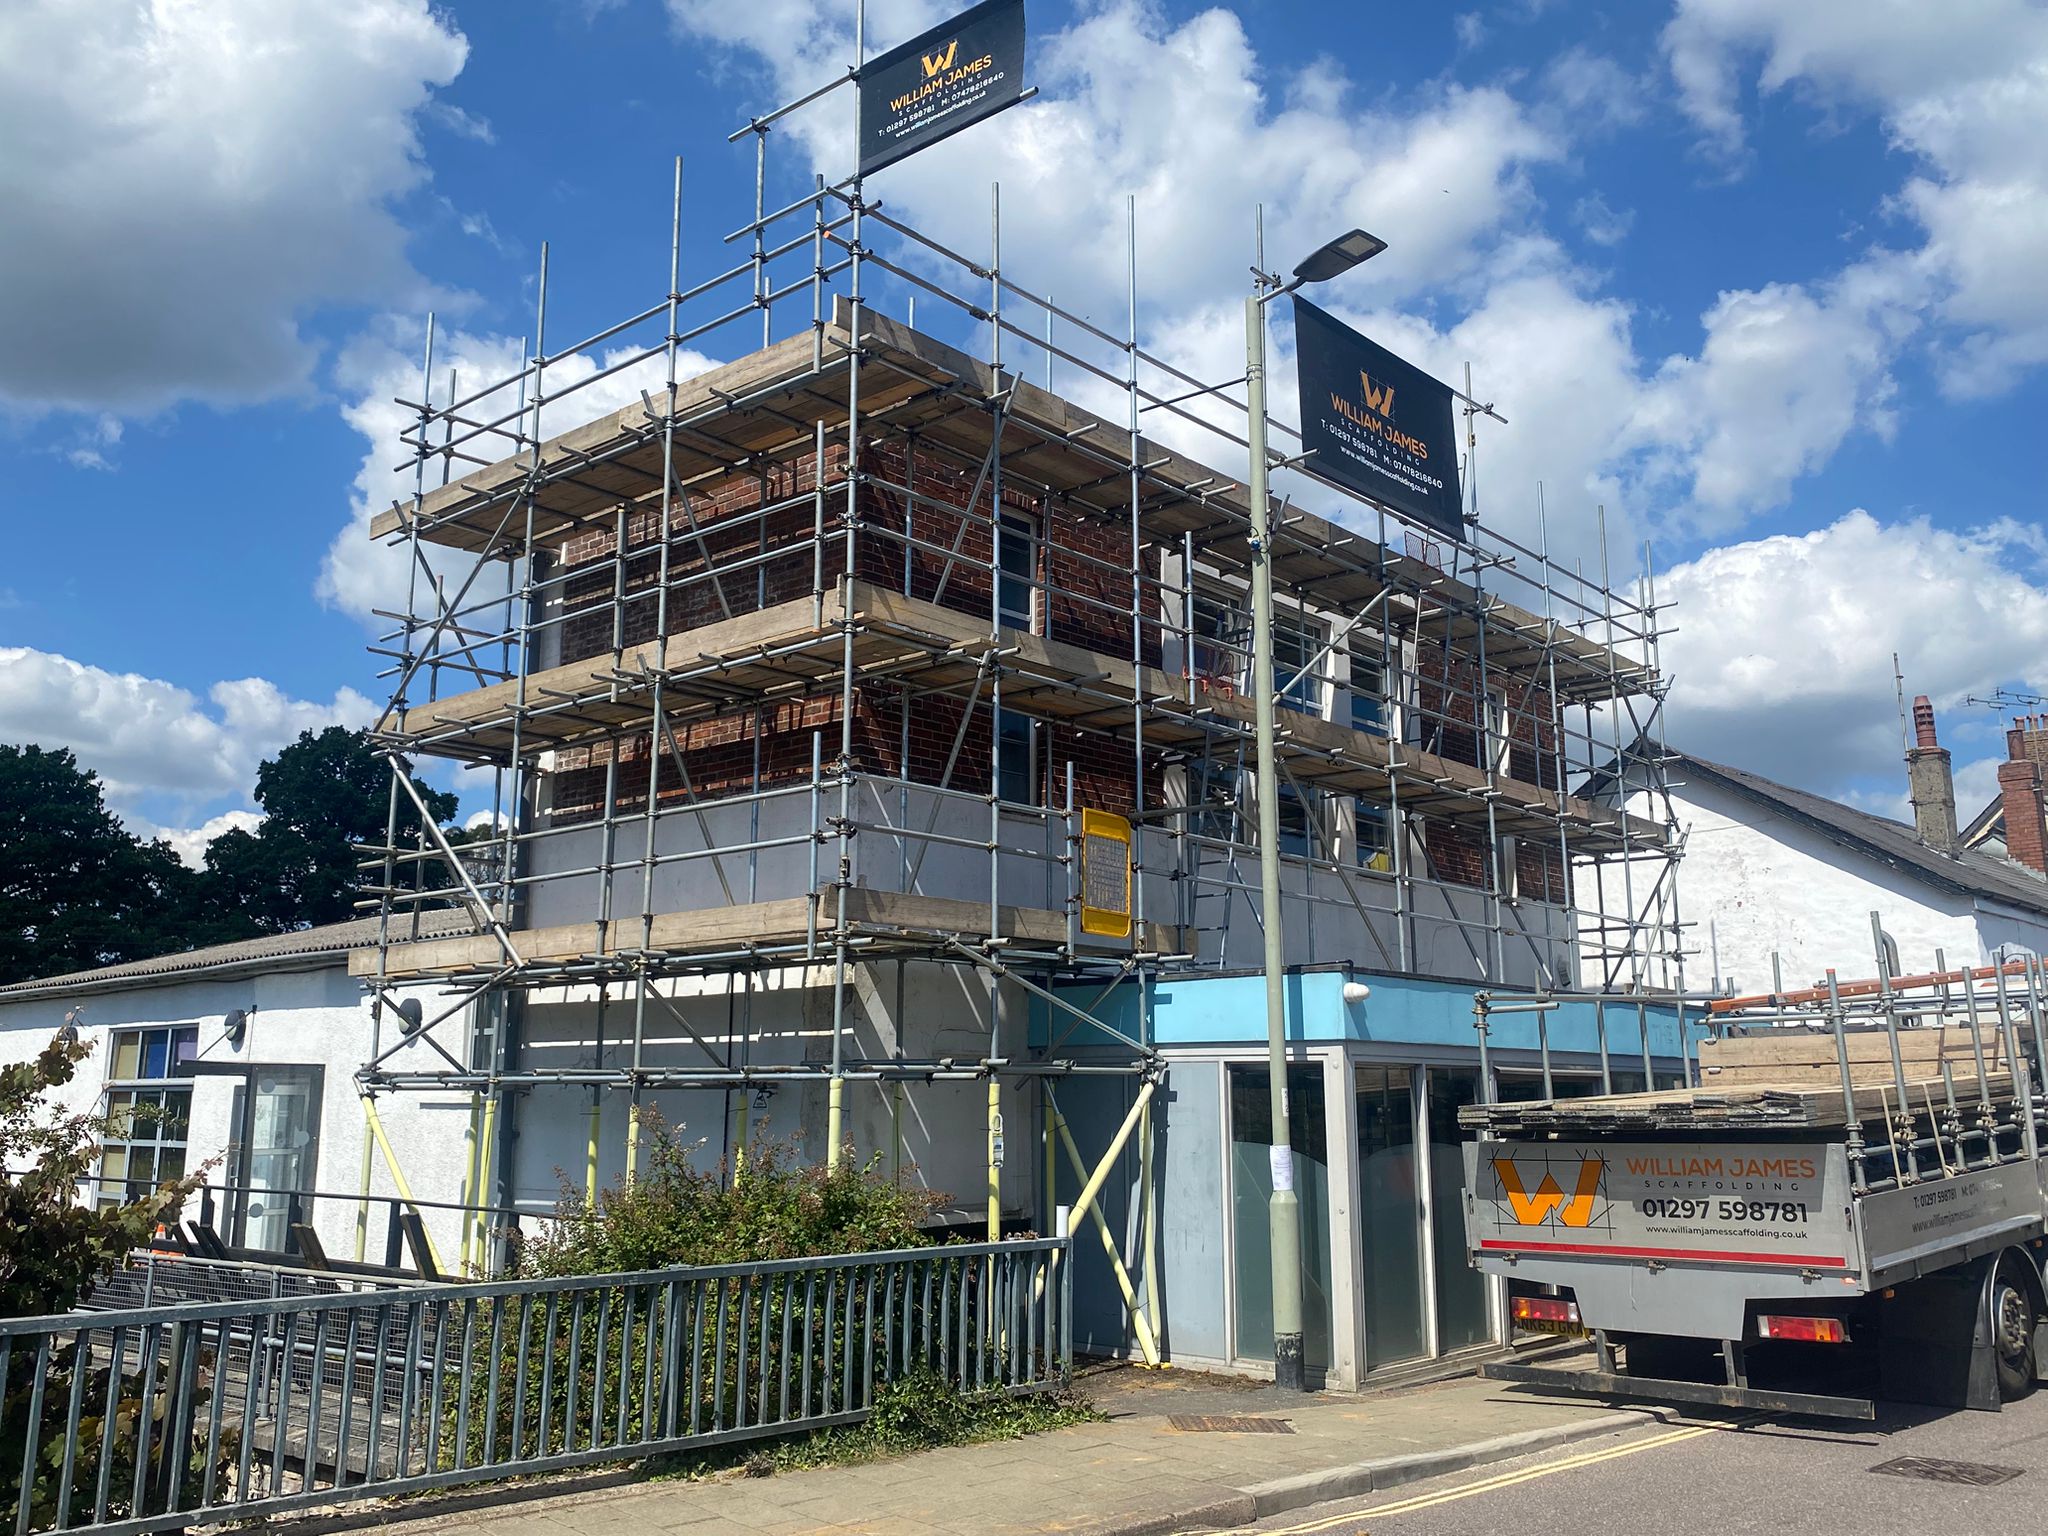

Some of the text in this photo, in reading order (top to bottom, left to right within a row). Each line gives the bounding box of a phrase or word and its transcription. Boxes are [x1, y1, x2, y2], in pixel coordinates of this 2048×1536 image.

[890, 54, 992, 112] WILLIAM JAMES
[898, 72, 982, 117] SCAFFOLDING
[878, 129, 885, 137] T:
[886, 117, 908, 133] 01297
[909, 104, 935, 122] 598781
[941, 98, 950, 107] M:
[1320, 419, 1328, 431] T:
[1329, 425, 1351, 443] 01297
[1352, 437, 1378, 459] 598781
[1383, 454, 1392, 465] M:
[1330, 392, 1428, 460] WILLIAM JAMES
[1341, 418, 1420, 465] SCAFFOLDING
[1626, 1157, 1816, 1179] WILLIAM JAMES
[1644, 1179, 1800, 1192] SCAFFOLDING
[1642, 1198, 1808, 1223] 01297 598781
[1913, 1196, 1920, 1208] T:
[1920, 1193, 1937, 1207] 01297
[1937, 1188, 1957, 1203] 598781
[1645, 1224, 1808, 1240] www.williamjamesscaffolding.co.uk
